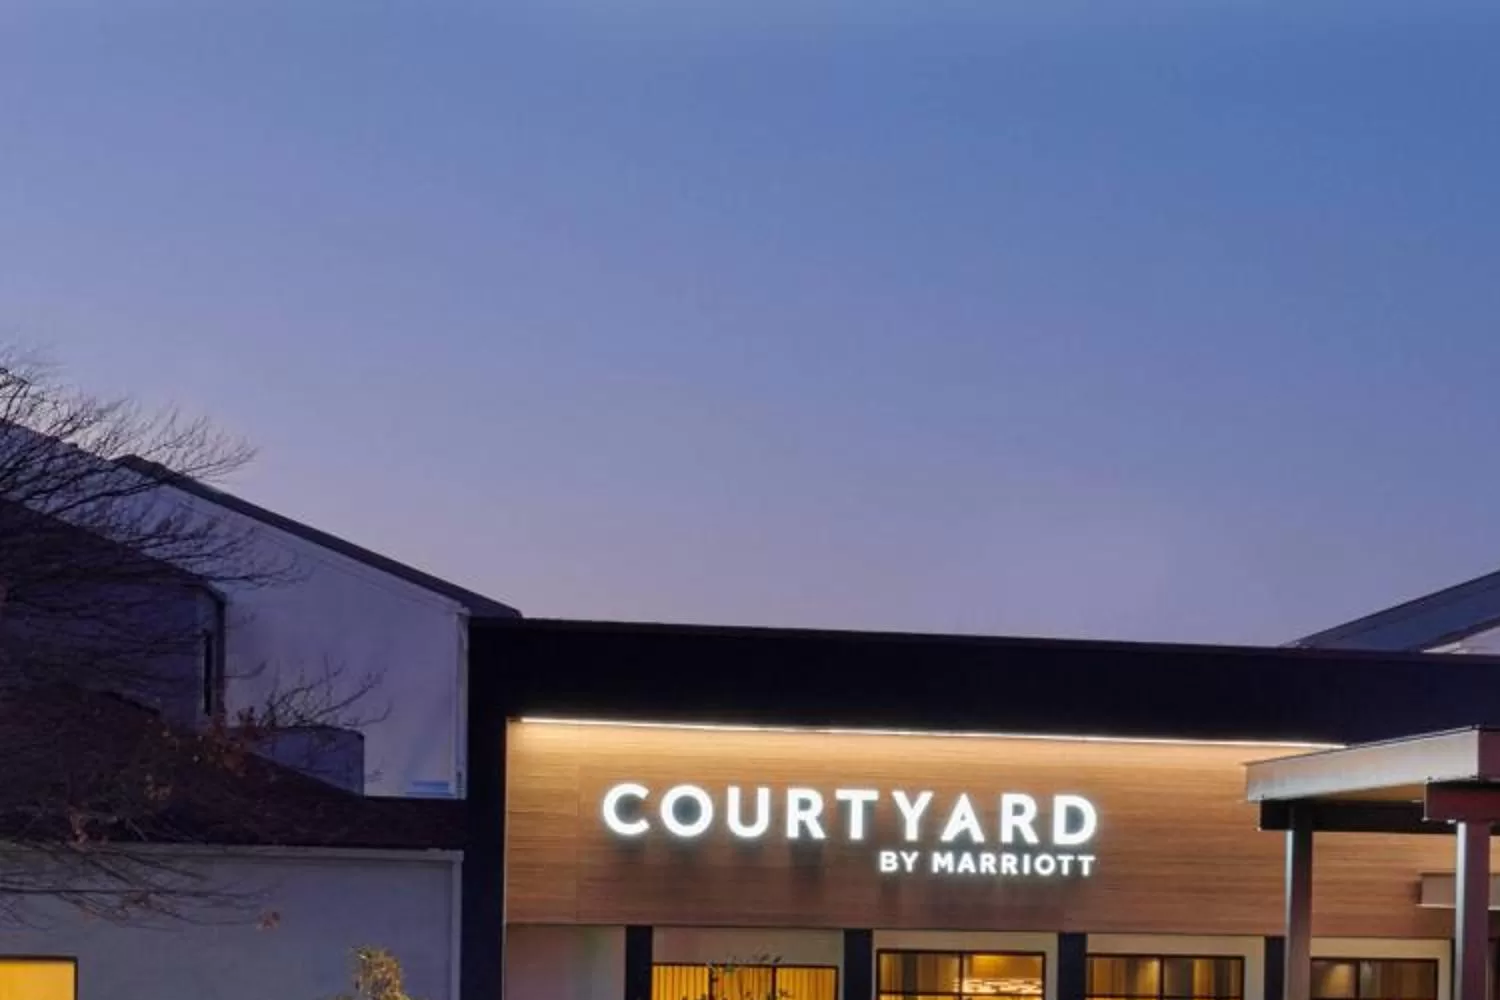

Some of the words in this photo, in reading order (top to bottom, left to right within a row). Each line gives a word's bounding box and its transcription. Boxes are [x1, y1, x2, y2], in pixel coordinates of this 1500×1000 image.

[602, 783, 1098, 846] COURTYARD
[879, 851, 919, 873] BY
[931, 852, 1096, 876] MARRIOTT
